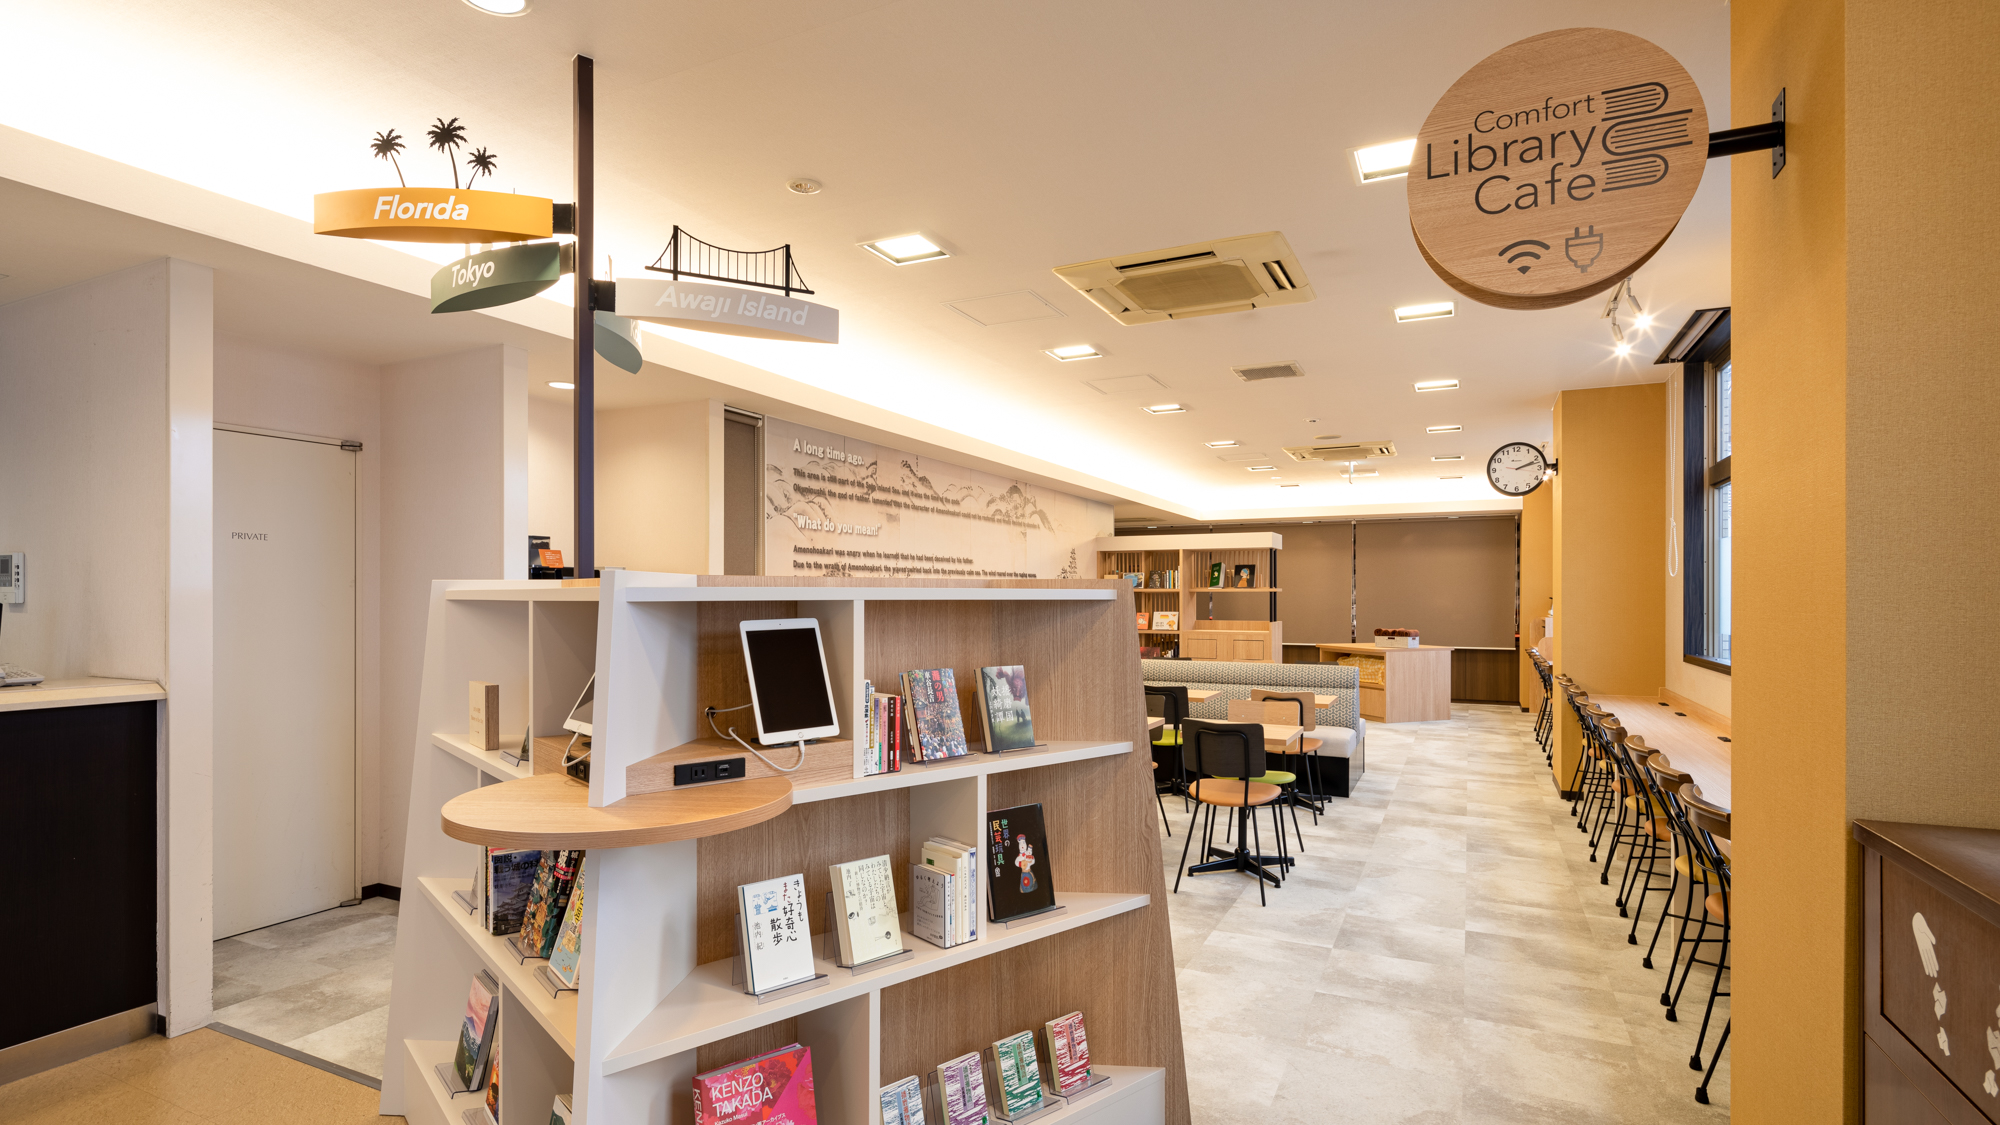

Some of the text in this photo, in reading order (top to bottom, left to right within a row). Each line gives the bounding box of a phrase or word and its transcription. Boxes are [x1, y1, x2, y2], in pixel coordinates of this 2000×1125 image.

[1473, 94, 1595, 133] Comfort
[1426, 125, 1597, 180] Library
[1474, 162, 1596, 215] Cafe
[373, 195, 469, 221] Florida
[451, 258, 495, 287] Tokyo
[655, 285, 809, 326] Awaji Island
[793, 438, 865, 465] A long time ago.
[793, 467, 807, 477] This
[807, 471, 820, 481] area
[821, 473, 826, 481] is
[827, 473, 837, 484] still
[838, 477, 849, 487] part
[850, 479, 856, 487] of
[857, 479, 865, 488] the
[827, 490, 836, 498] the
[838, 491, 847, 501] god
[848, 493, 854, 501] of
[911, 502, 930, 513] character
[231, 531, 269, 541] PRIVATE
[793, 513, 882, 536] "What do you mean!"
[793, 544, 834, 555] Amenohoakari
[835, 550, 845, 558] was
[846, 550, 861, 558] angry
[862, 550, 875, 558] when
[876, 551, 882, 559] he
[883, 551, 899, 560] learned
[910, 553, 915, 561] he
[924, 554, 933, 562] been
[951, 556, 956, 564] by
[793, 560, 804, 569] Due
[806, 561, 812, 569] to
[813, 561, 823, 570] the
[824, 562, 840, 571] wrath
[841, 562, 847, 571] of
[883, 565, 891, 573] the
[948, 568, 966, 576] previously
[924, 671, 935, 703] 車谷長吉
[931, 670, 945, 703] 灘の男
[1000, 684, 1015, 722] 播磨国
[992, 819, 1005, 866] 民芸玩具
[1000, 818, 1011, 847] 世界の
[793, 878, 804, 922] きょうも
[769, 917, 783, 946] 散歩
[711, 1072, 764, 1102] KENZO
[712, 1086, 773, 1117] TAKADA
[733, 1111, 748, 1121] Masui
